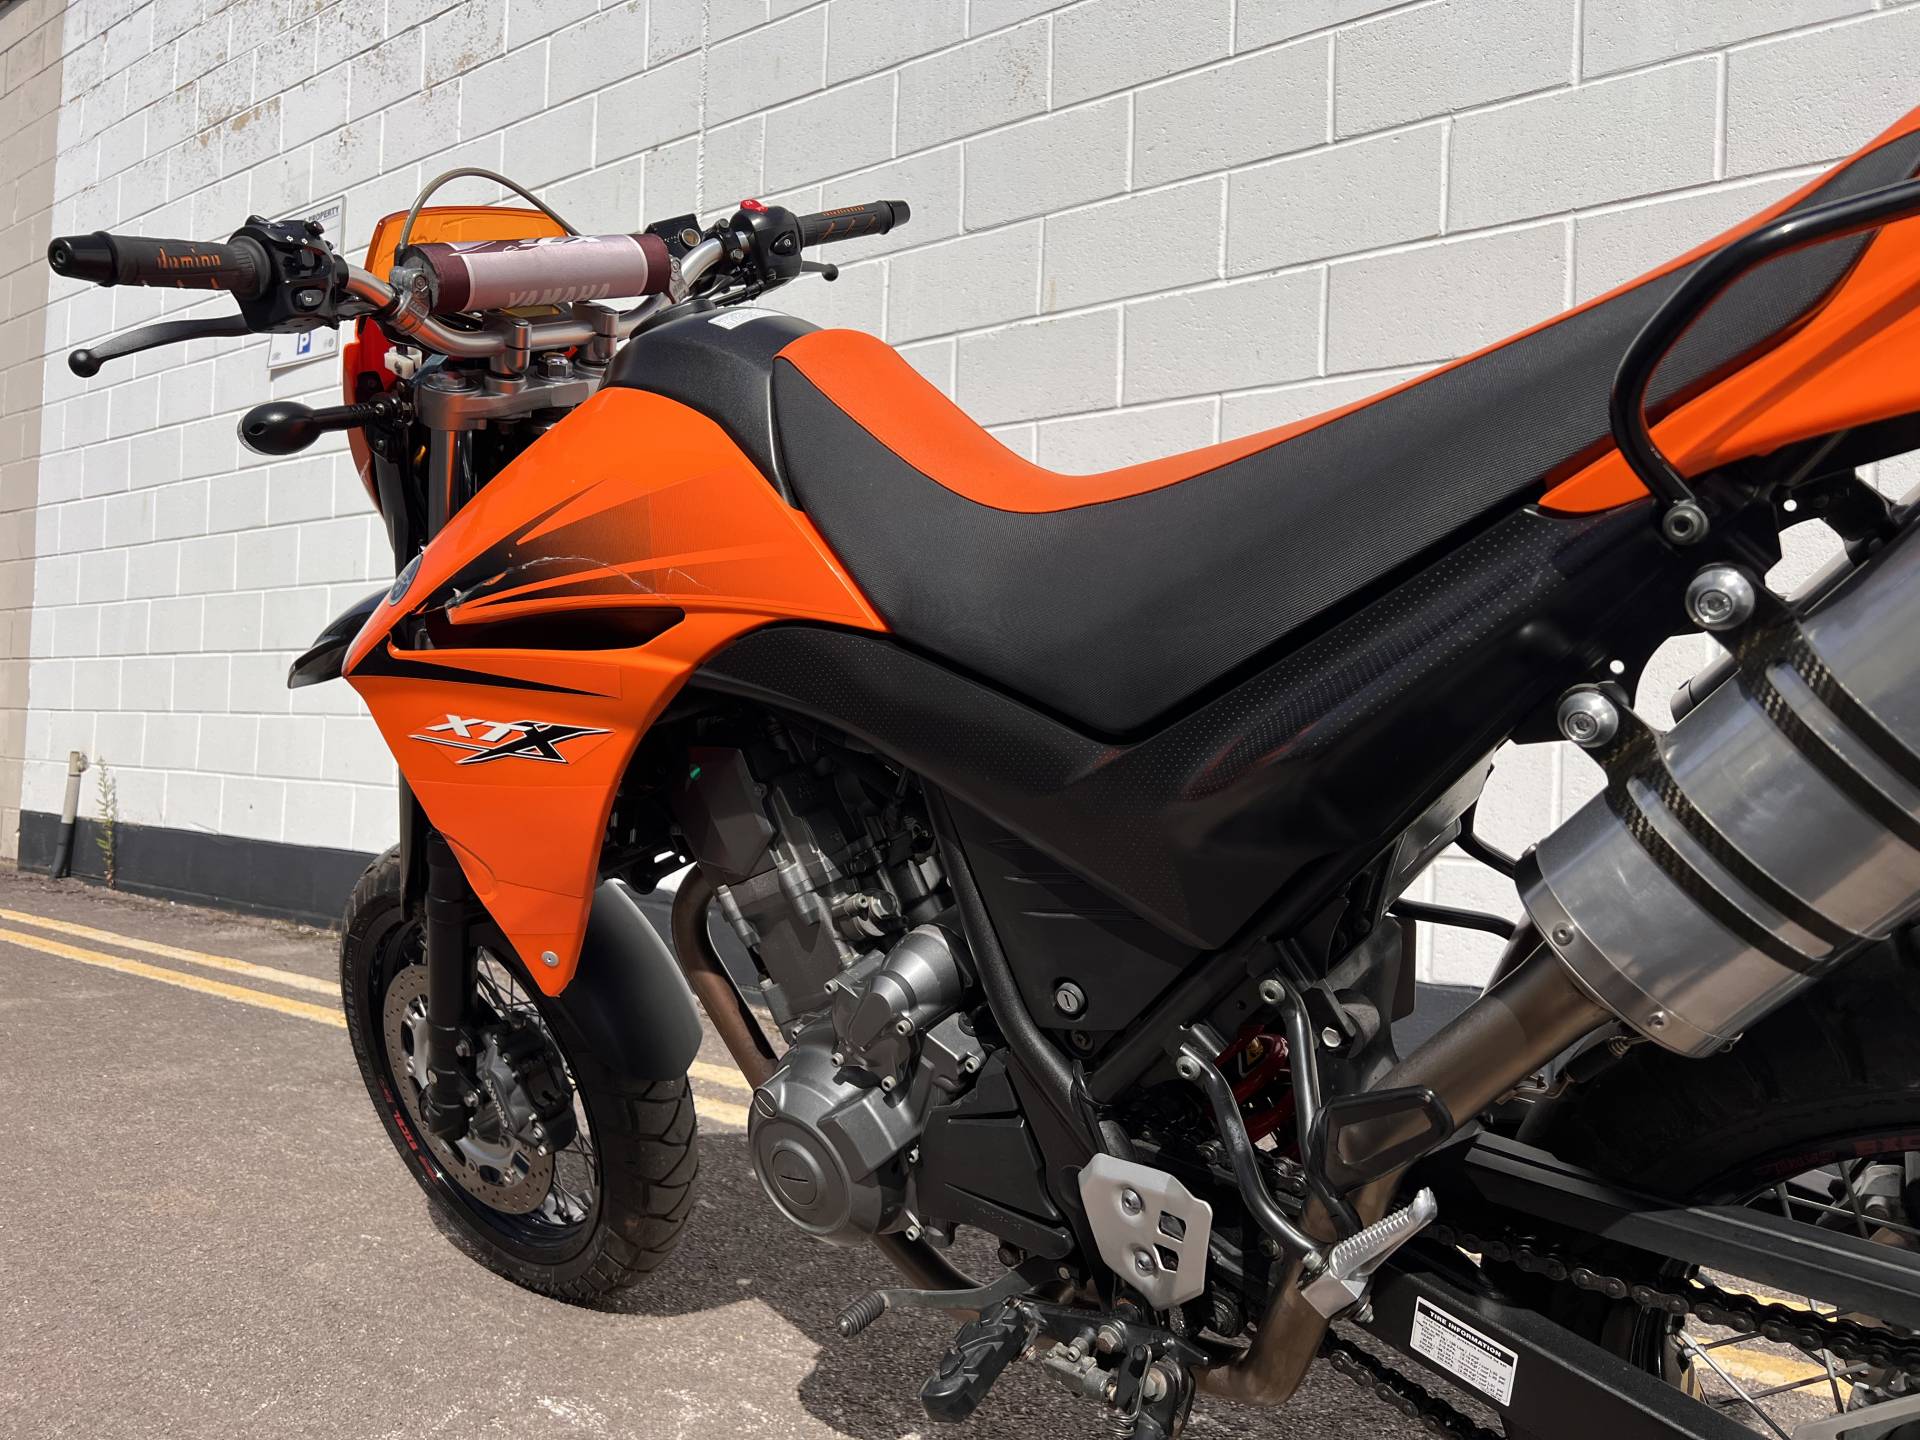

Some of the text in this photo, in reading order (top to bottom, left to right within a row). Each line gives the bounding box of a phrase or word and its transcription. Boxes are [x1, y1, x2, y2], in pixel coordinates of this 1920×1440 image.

[507, 283, 610, 308] YAMAHA
[1429, 1310, 1501, 1358] TIRE INFORMATION
